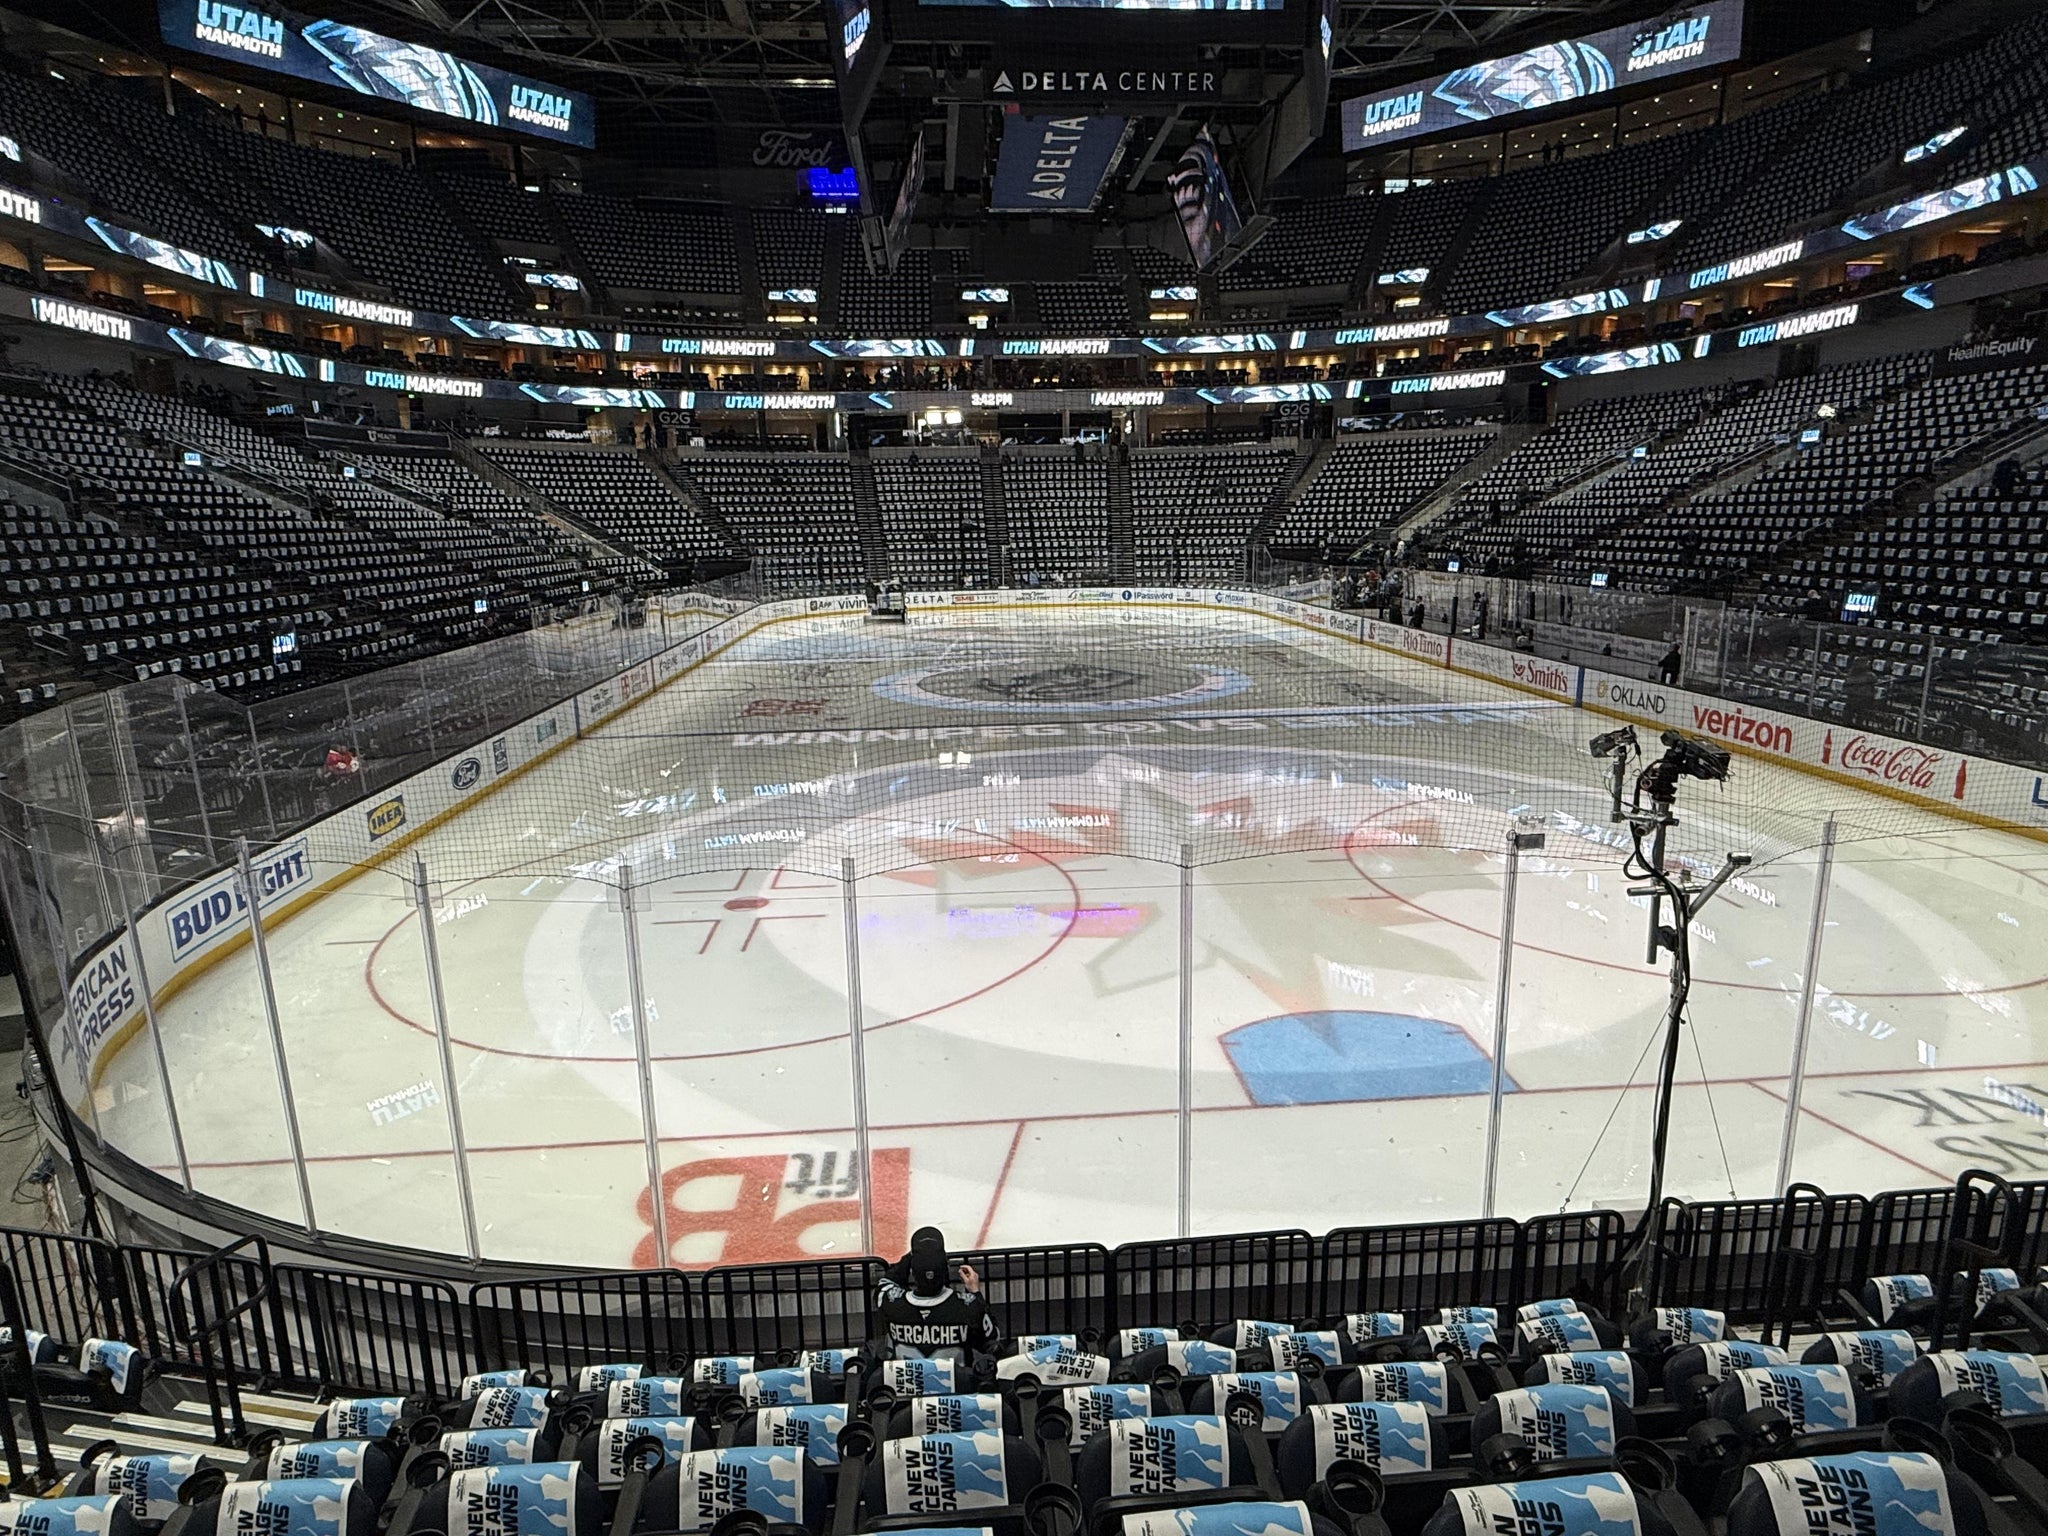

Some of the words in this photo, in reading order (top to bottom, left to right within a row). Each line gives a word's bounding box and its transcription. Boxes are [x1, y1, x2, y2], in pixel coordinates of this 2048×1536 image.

[198, 0, 284, 44] UTAH
[196, 23, 282, 58] MAMMOTH
[1628, 41, 1704, 72] MAMMOTH
[1022, 72, 1108, 91] DELTA
[1118, 72, 1214, 91] CENTER
[511, 85, 572, 119] UTAH
[1365, 91, 1423, 124] UTAH
[508, 105, 569, 131] MAMMOTH
[1362, 112, 1421, 136] MAMMOTH
[752, 130, 832, 166] Ford
[1032, 116, 1088, 182] DELTA
[1689, 264, 1730, 289] UTAH
[1727, 240, 1803, 279] MAMMOTH
[39, 299, 131, 340] MAMMOTH
[296, 288, 333, 312] UTAH
[334, 298, 413, 327] MAMMOTH
[1335, 328, 1373, 344] UTAH
[1373, 319, 1449, 341] MAMMOTH
[1738, 324, 1777, 347] UTAH
[1775, 304, 1858, 340] MAMMOTH
[662, 339, 700, 353] UTAH
[701, 341, 775, 355] MAMMOTH
[1002, 341, 1039, 354] UTAH
[1039, 340, 1110, 354] MAMMOTH
[1948, 337, 2037, 362] HealthEquity
[364, 371, 404, 390] UTAH
[406, 376, 483, 397] MAMMOTH
[1391, 377, 1430, 394] UTAH
[1430, 370, 1505, 391] MAMMOTH
[725, 396, 763, 409] UTAH
[763, 395, 836, 409] MAMMOTH
[1095, 392, 1164, 405] MAMMOTH
[1280, 403, 1310, 416] G2G
[659, 411, 691, 424] G2G
[838, 596, 866, 609] vivin
[905, 595, 944, 604] DELTA
[1403, 630, 1418, 650] Rio
[1418, 633, 1442, 657] Tinto
[1527, 659, 1568, 692] Smith's
[1611, 685, 1666, 714] OKLAND
[1693, 705, 1792, 753] verizon
[371, 807, 402, 830] IKEA
[171, 888, 232, 949] BUD
[233, 850, 304, 912] LGHT
[61, 944, 127, 1065] AERICAN
[784, 1151, 859, 1199] fit
[889, 1322, 968, 1344] SERGACHEV
[1054, 1354, 1075, 1366] AGE
[1077, 1359, 1095, 1369] ICE
[1281, 1340, 1291, 1367] NEW
[895, 1367, 906, 1394] NEW
[905, 1361, 915, 1385] AGE
[1056, 1366, 1082, 1379] NEW
[1084, 1367, 1093, 1380] A
[1373, 1370, 1385, 1402] NEW
[1385, 1365, 1397, 1394] AGE
[487, 1388, 503, 1416] NEW
[499, 1386, 515, 1411] AGE
[621, 1386, 631, 1413] NEW
[631, 1381, 642, 1406] AGE
[640, 1383, 651, 1416] AWNS
[1091, 1391, 1102, 1421] AGE
[1786, 1376, 1805, 1437] AWNS
[339, 1411, 349, 1437] NEW
[349, 1405, 360, 1430] AGE
[502, 1391, 522, 1427] AWNS
[926, 1404, 938, 1434] NEW
[938, 1397, 950, 1427] AGE
[1079, 1397, 1092, 1430] NEW
[1349, 1406, 1366, 1441] AGE
[1332, 1412, 1350, 1459] NEW
[1536, 1409, 1552, 1442] AGE
[610, 1429, 625, 1464] NEW
[1129, 1432, 1145, 1479] NEW
[1145, 1424, 1160, 1464] AGE
[122, 1458, 140, 1489] AGE
[610, 1464, 623, 1478] A
[906, 1450, 923, 1496] NEW
[921, 1440, 937, 1480] AGE
[134, 1461, 151, 1517] DAWNS
[715, 1462, 731, 1504] AGE
[732, 1464, 748, 1510] WNS
[938, 1441, 956, 1513] DAWNS
[1129, 1483, 1144, 1495] A
[486, 1482, 502, 1525] AGE
[698, 1471, 714, 1516] NEW
[908, 1499, 925, 1514] A
[1812, 1464, 1848, 1530] AGE
[1839, 1467, 1877, 1536] WNS
[468, 1492, 484, 1536] NEW
